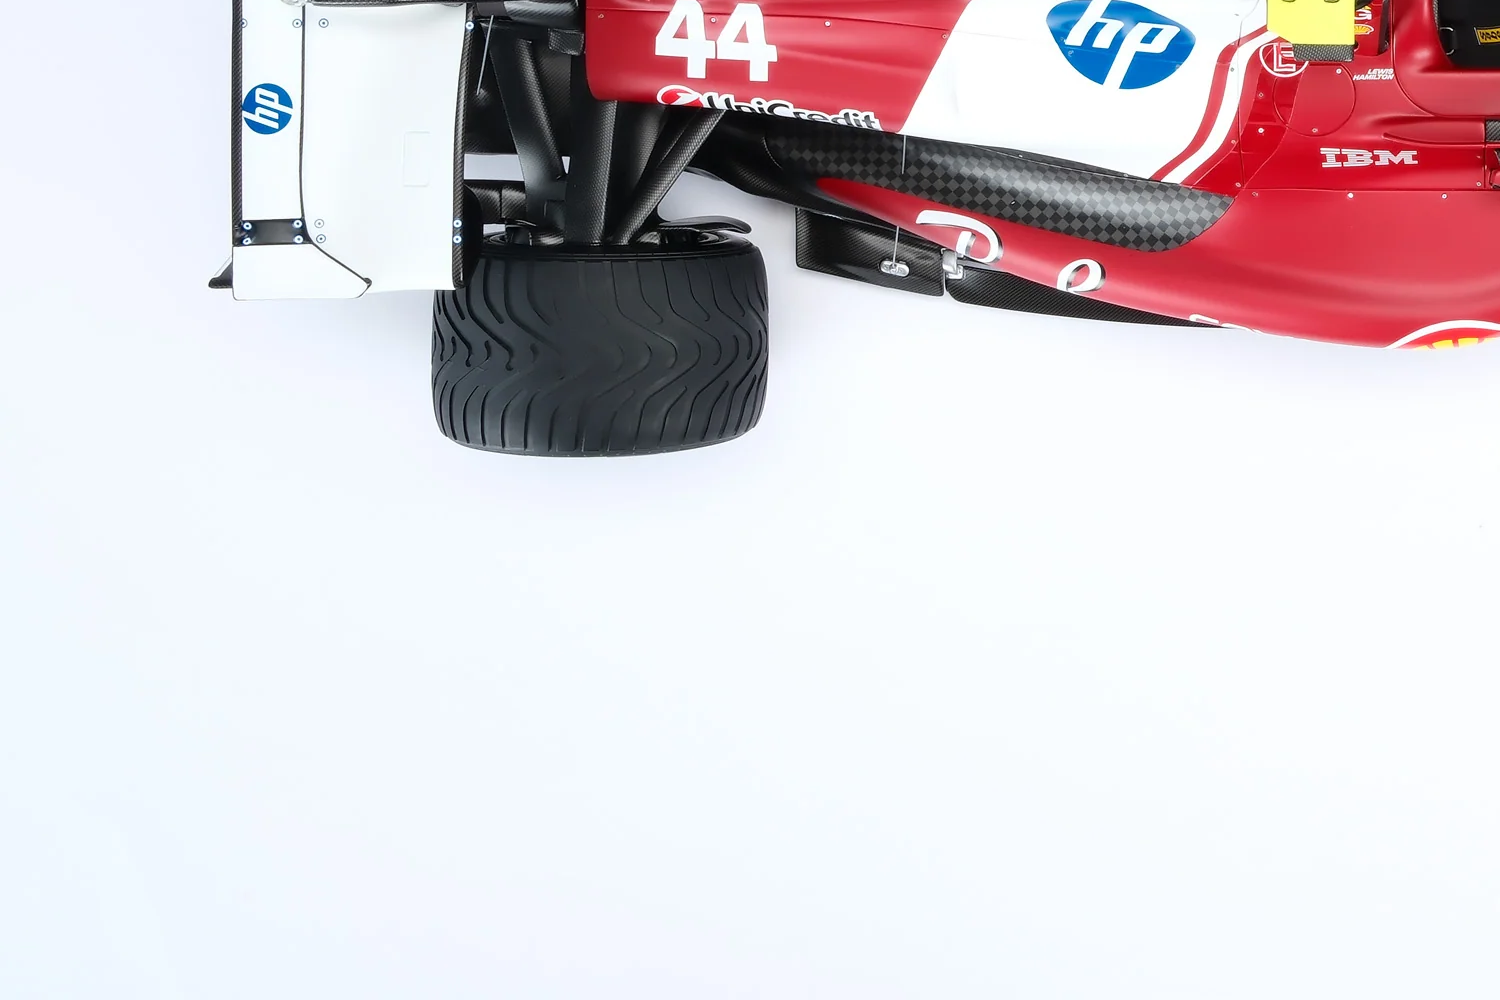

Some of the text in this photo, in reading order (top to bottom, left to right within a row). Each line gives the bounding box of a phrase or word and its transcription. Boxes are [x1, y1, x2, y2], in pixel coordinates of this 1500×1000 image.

[1062, 0, 1186, 89] hp
[242, 83, 293, 134] hp
[1320, 147, 1419, 168] IBM
